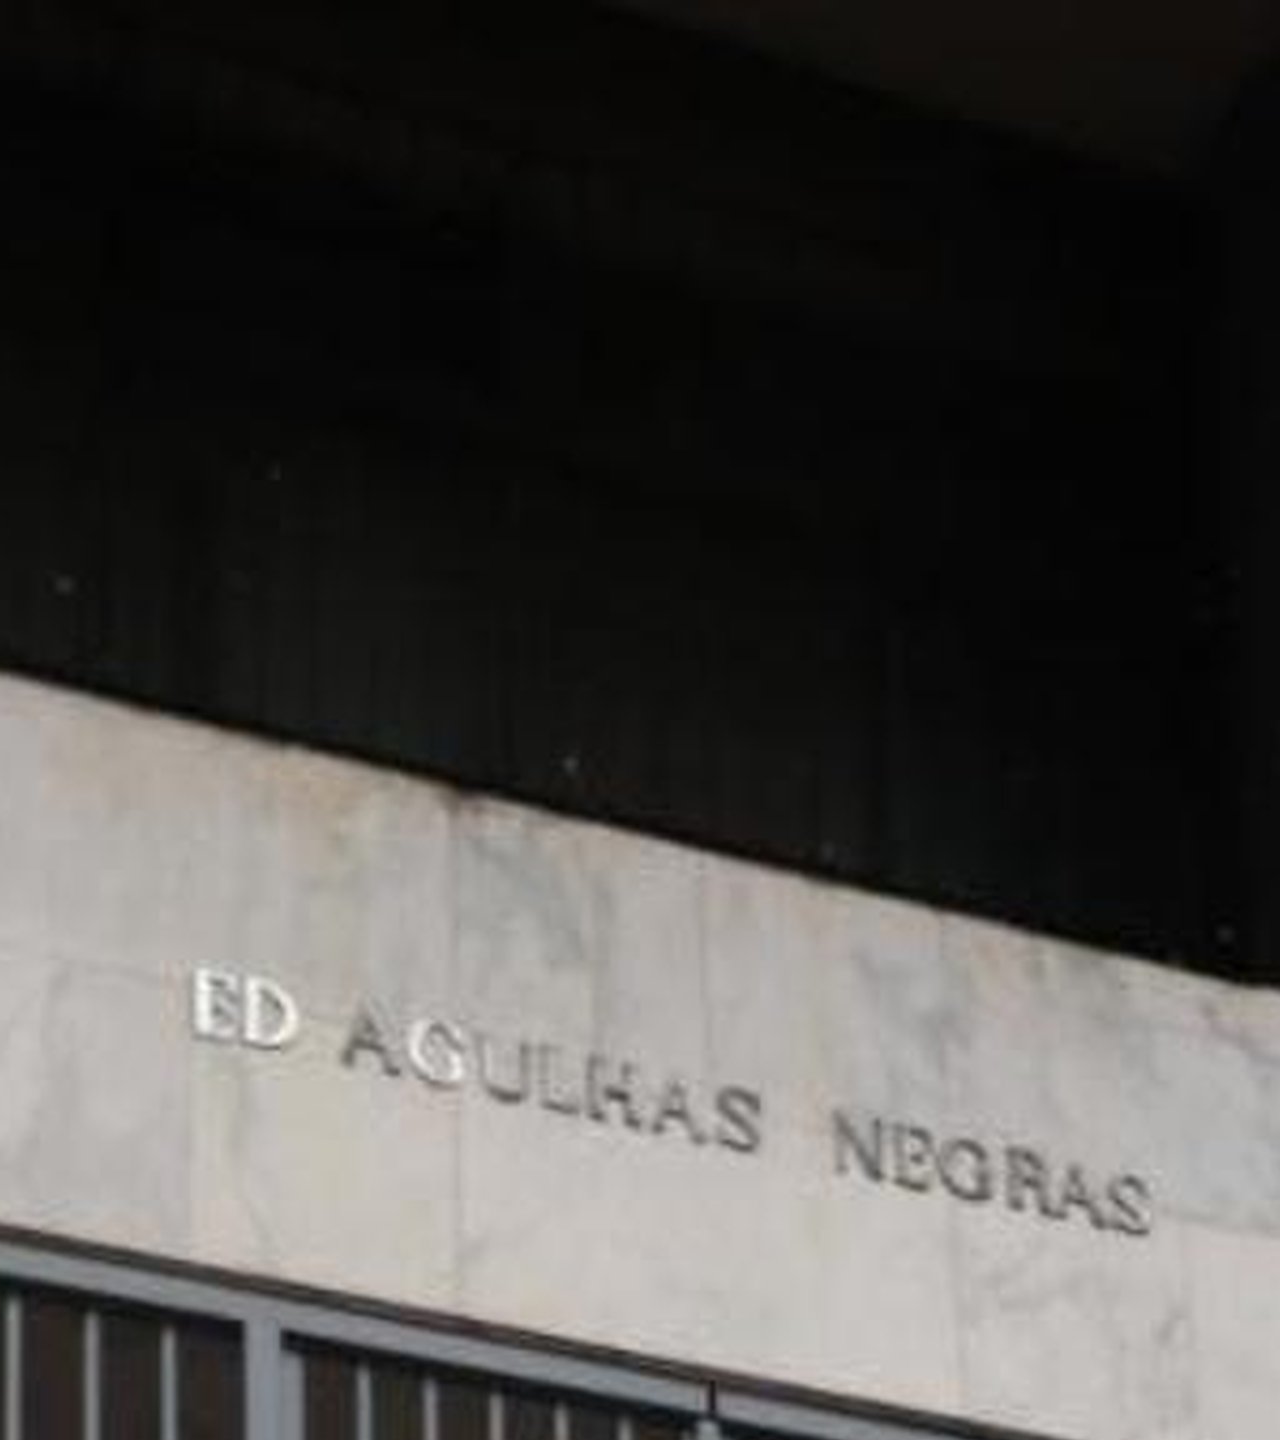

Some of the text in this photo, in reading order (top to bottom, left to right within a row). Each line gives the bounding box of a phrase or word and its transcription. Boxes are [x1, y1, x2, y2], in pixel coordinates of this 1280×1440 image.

[192, 965, 1151, 1236] ED AGULHAS NEGRAS
